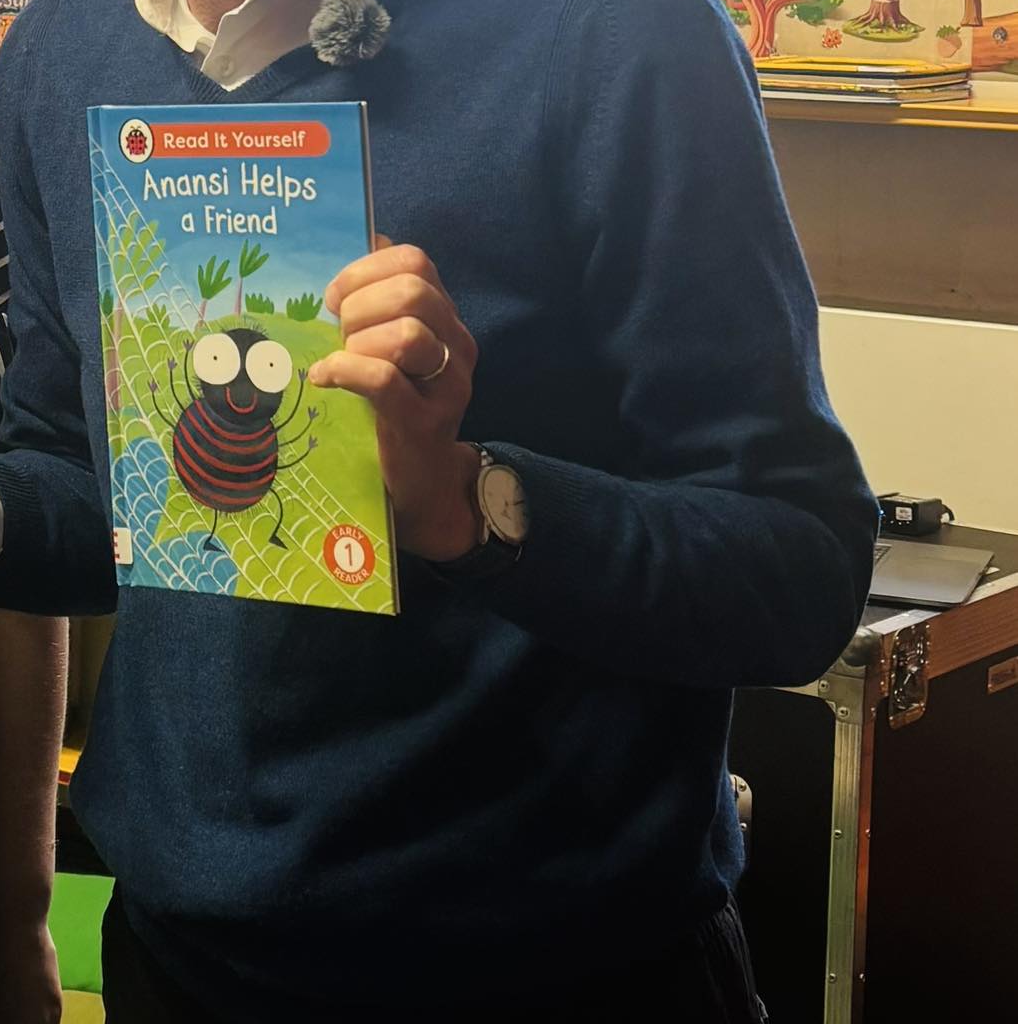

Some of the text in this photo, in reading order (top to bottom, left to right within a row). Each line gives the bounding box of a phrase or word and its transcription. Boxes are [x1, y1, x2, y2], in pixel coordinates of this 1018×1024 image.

[163, 130, 307, 149] Read It Yourself
[143, 161, 318, 208] Anansi Helps
[181, 204, 278, 236] a Friend
[332, 526, 364, 541] EARLY
[344, 543, 353, 567] 1
[333, 567, 370, 584] READER
